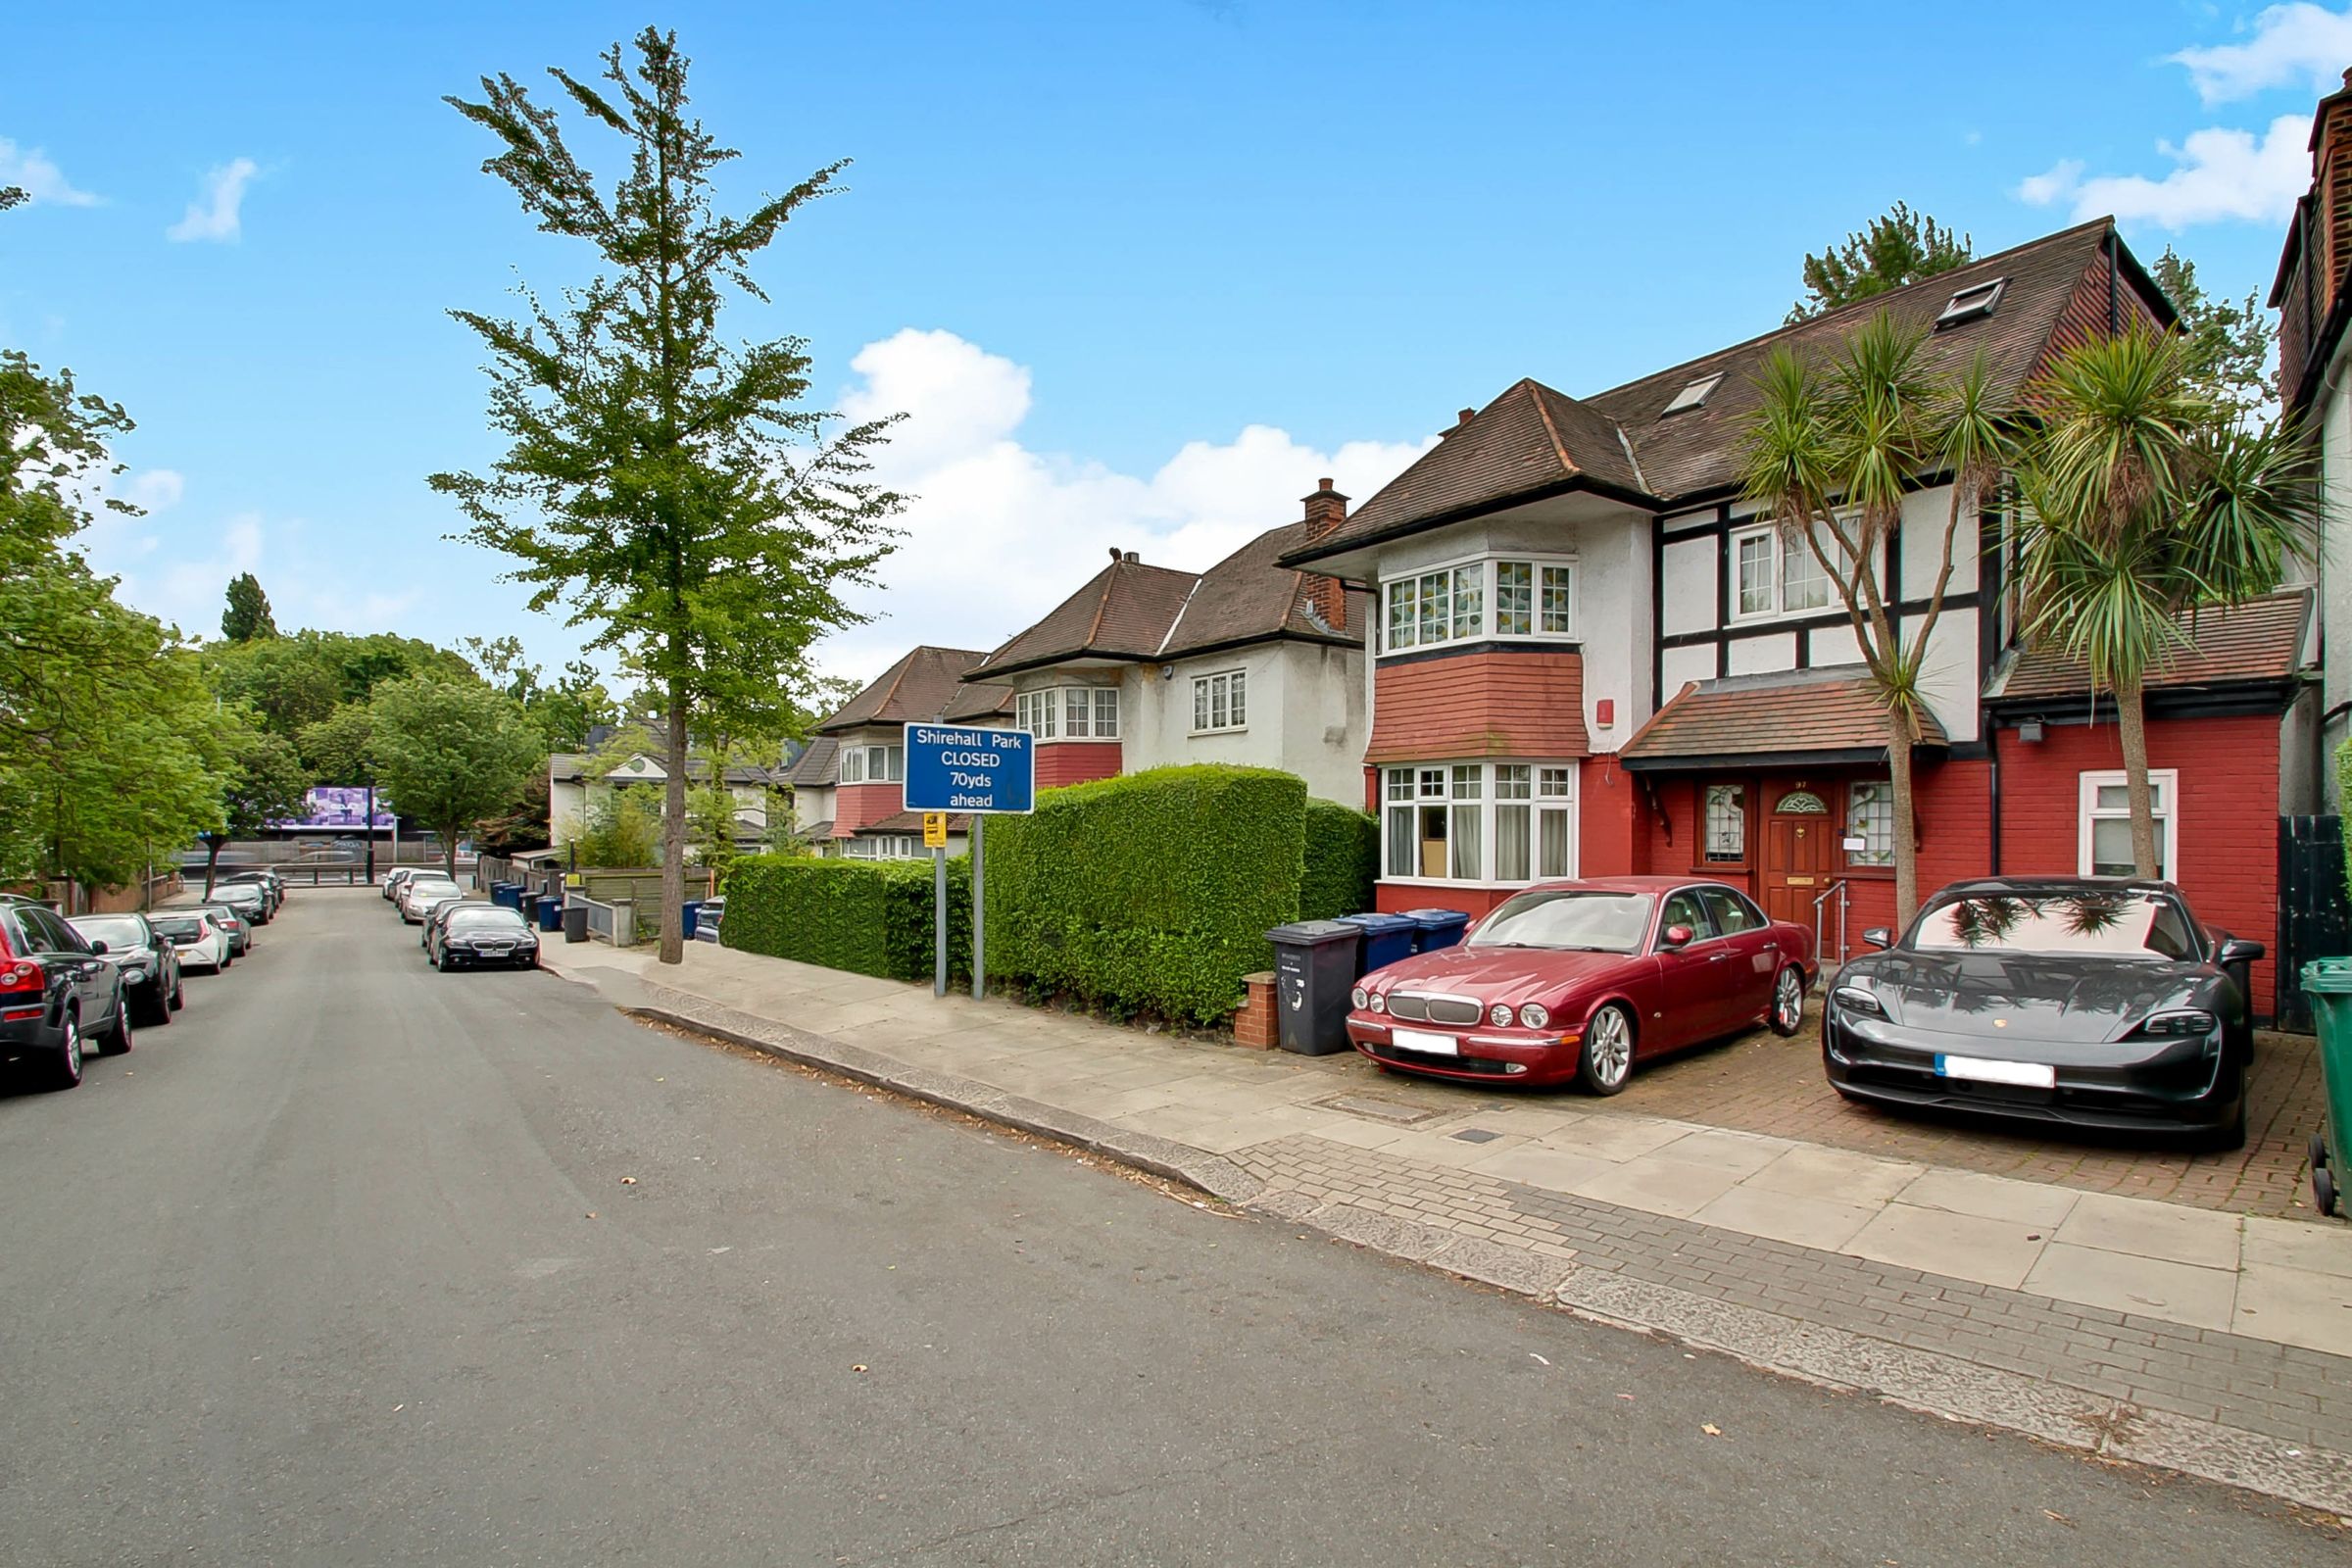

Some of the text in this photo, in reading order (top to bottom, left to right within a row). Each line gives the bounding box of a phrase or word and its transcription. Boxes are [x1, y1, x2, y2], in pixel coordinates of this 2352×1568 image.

[916, 729, 1021, 749] Shirehall Park
[941, 751, 1000, 767] CLOSED
[950, 771, 991, 789] 70yds
[950, 793, 993, 807] ahead
